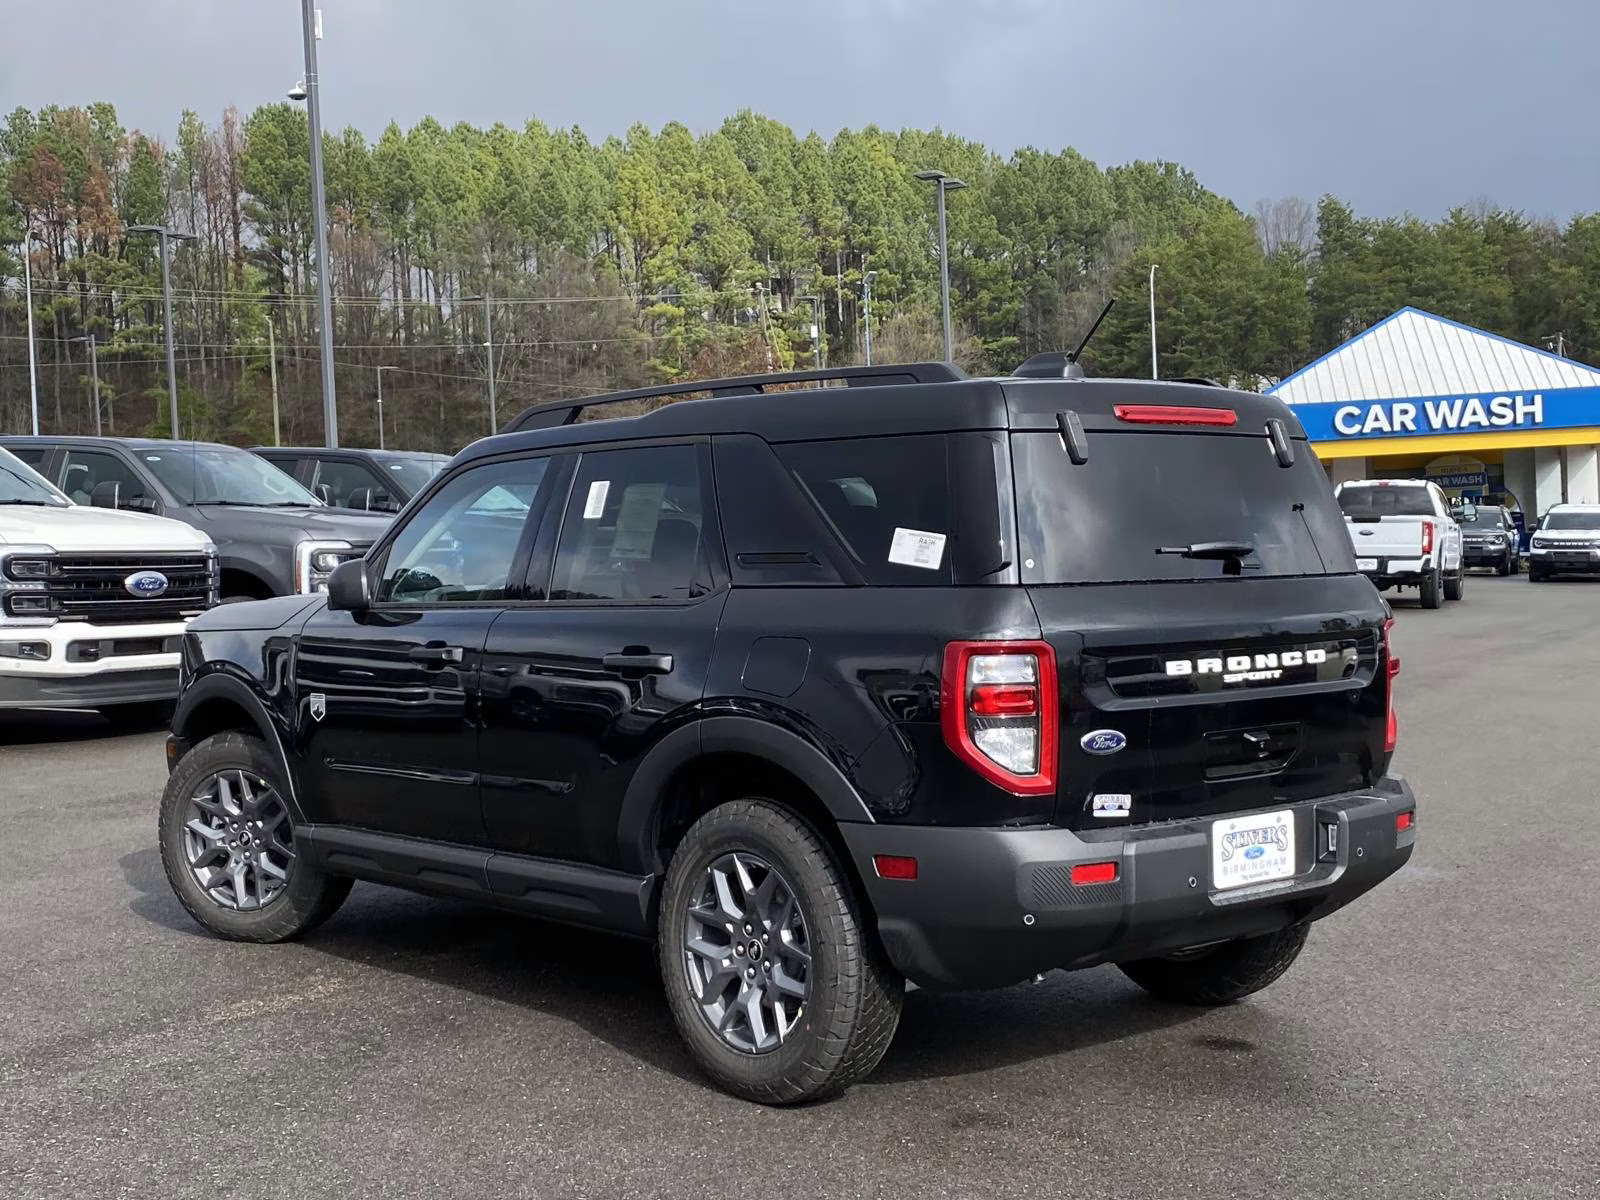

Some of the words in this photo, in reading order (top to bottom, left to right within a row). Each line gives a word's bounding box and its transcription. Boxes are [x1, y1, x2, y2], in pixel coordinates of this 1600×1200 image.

[1334, 402, 1417, 435] CAR
[1424, 394, 1543, 430] WASH
[1430, 477, 1450, 487] AR
[1451, 475, 1482, 486] WASH
[1165, 648, 1327, 676] BRONCO
[1223, 669, 1283, 683] SPORT
[1092, 734, 1118, 749] Ford
[1221, 824, 1289, 862] STIVERS
[1223, 856, 1287, 876] BIRMINGHAM
